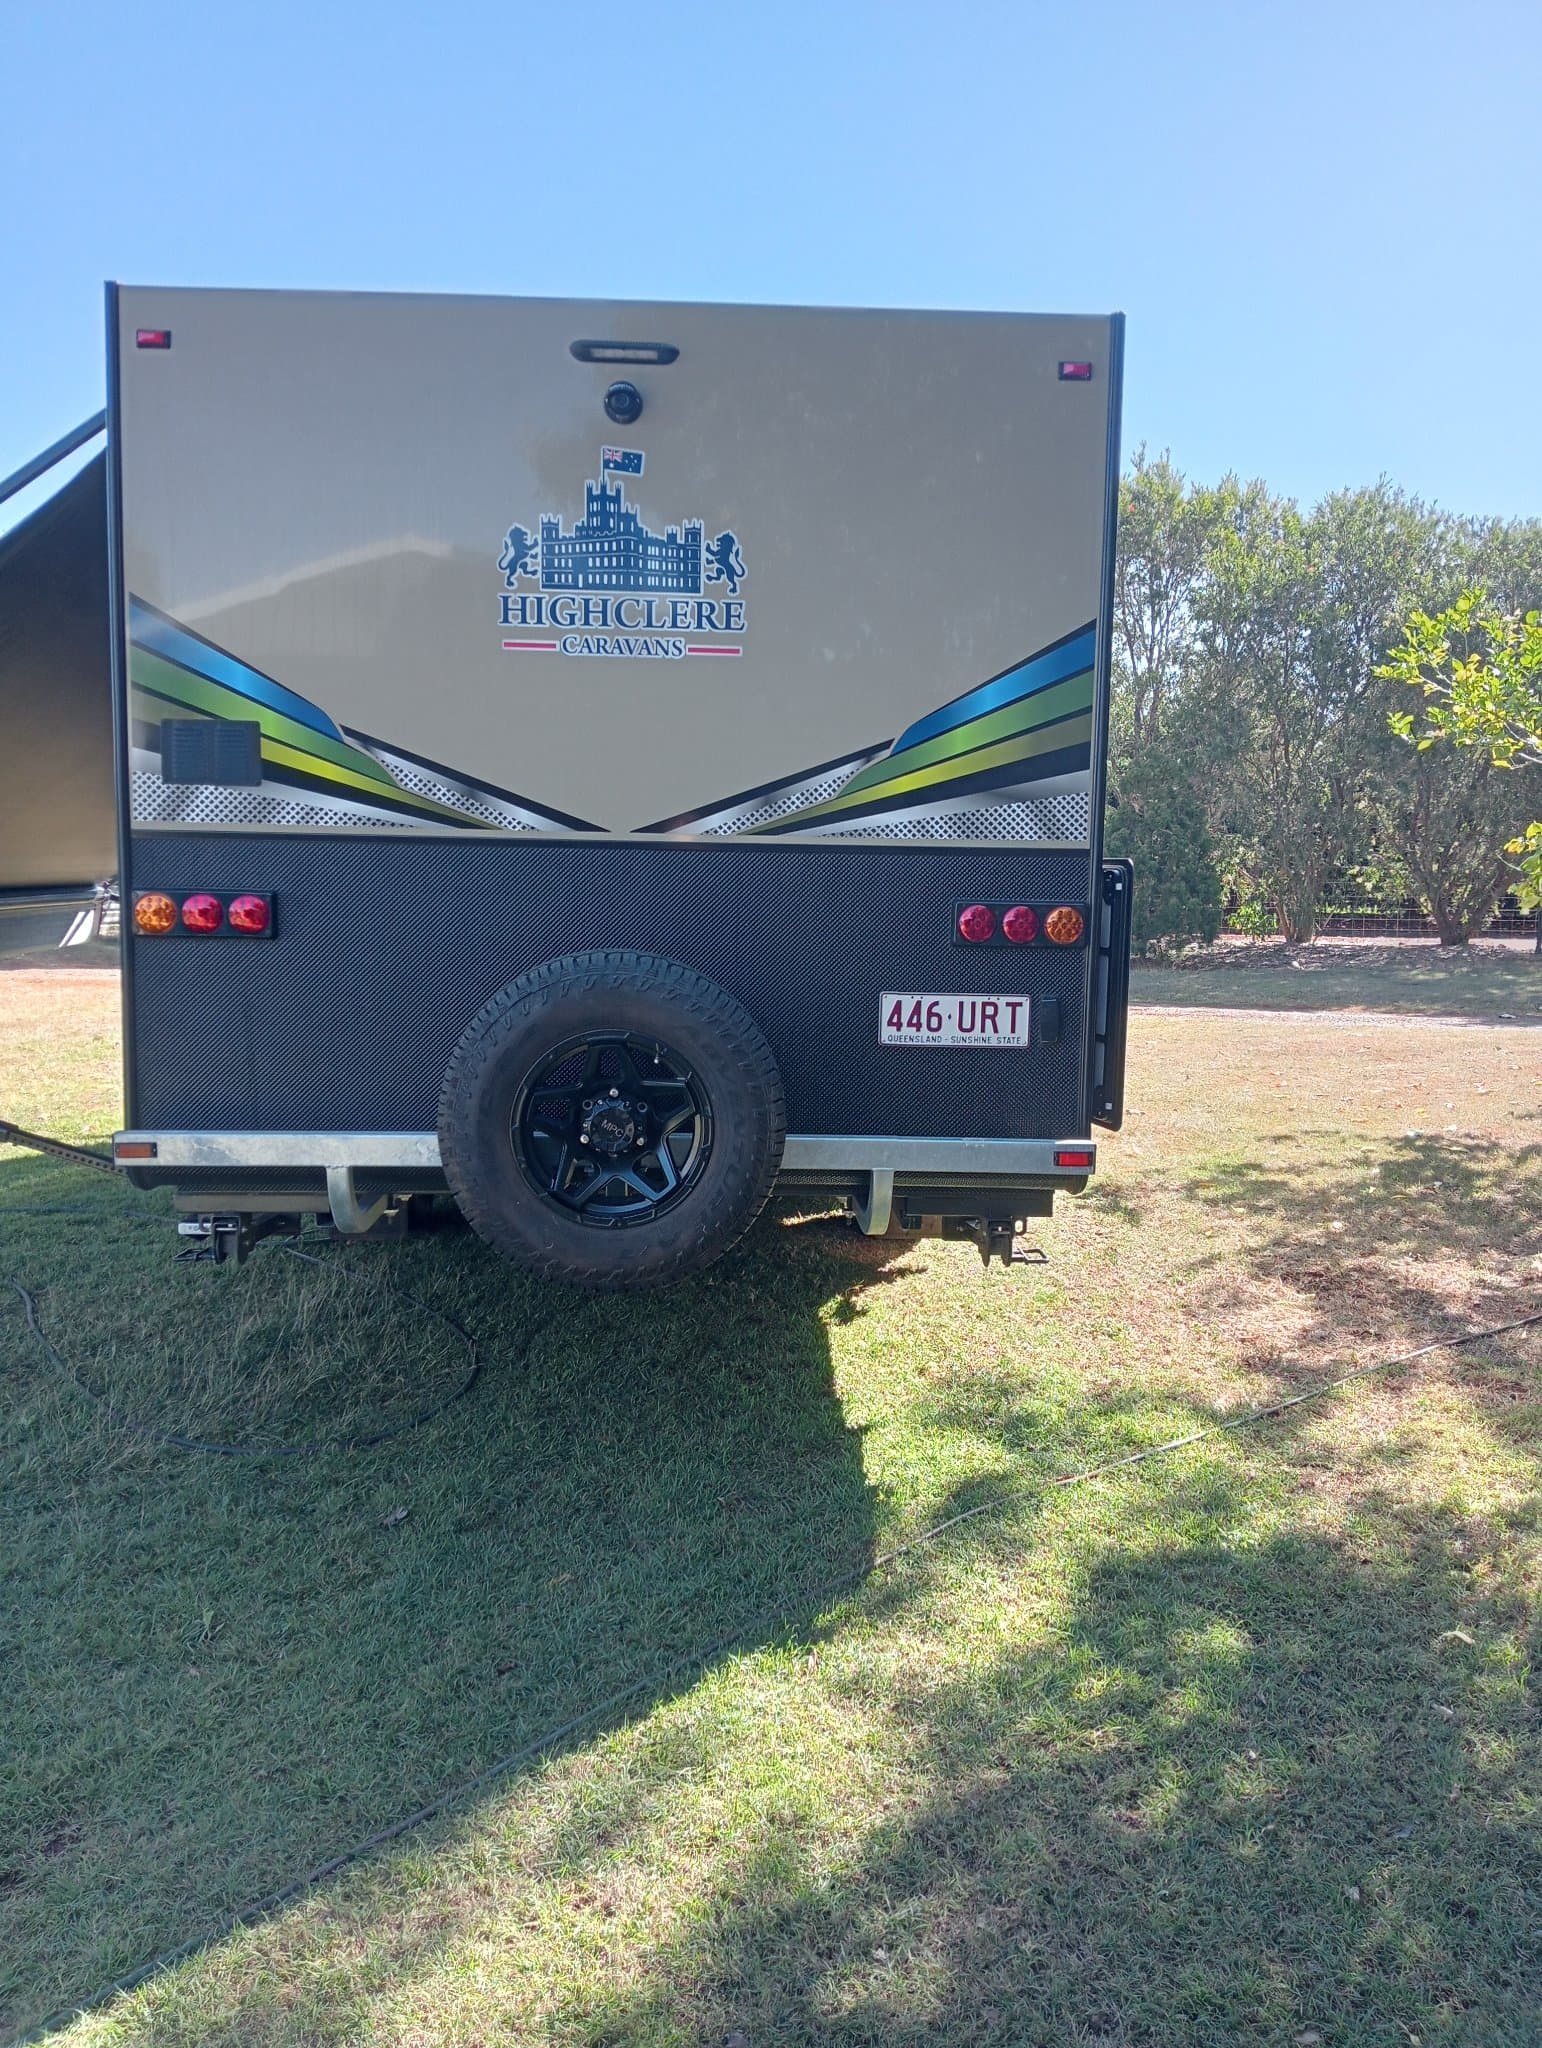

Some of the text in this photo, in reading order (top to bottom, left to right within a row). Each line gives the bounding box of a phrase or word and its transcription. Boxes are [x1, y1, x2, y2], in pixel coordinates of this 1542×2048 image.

[499, 595, 746, 631] HIGHCLERE
[562, 637, 683, 656] CARAVANS
[887, 1035, 943, 1044] QUEENSLAND
[951, 1036, 993, 1045] SUNSHINE
[996, 1037, 1022, 1045] STATE
